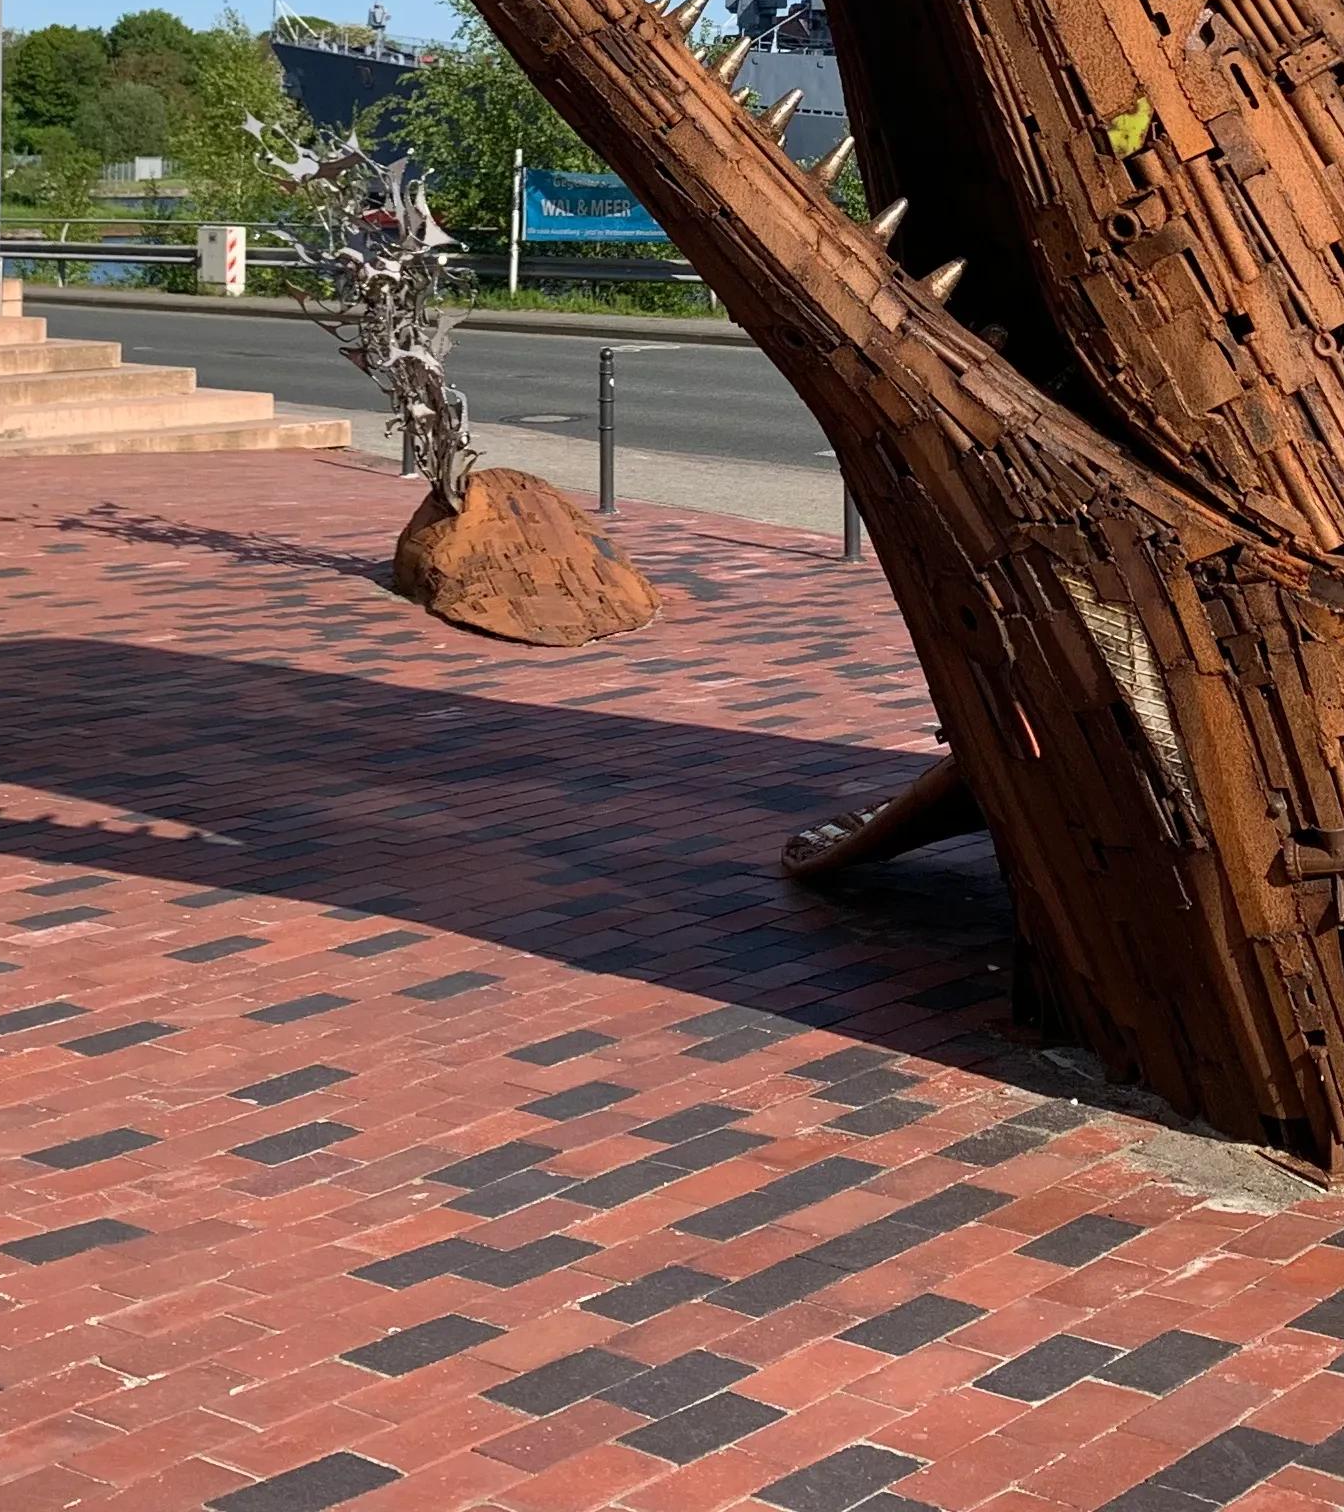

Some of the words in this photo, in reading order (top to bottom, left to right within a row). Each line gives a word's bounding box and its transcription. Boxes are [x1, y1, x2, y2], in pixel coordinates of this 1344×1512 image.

[540, 198, 575, 217] WAL
[576, 199, 588, 217] &
[590, 199, 631, 218] MEER
